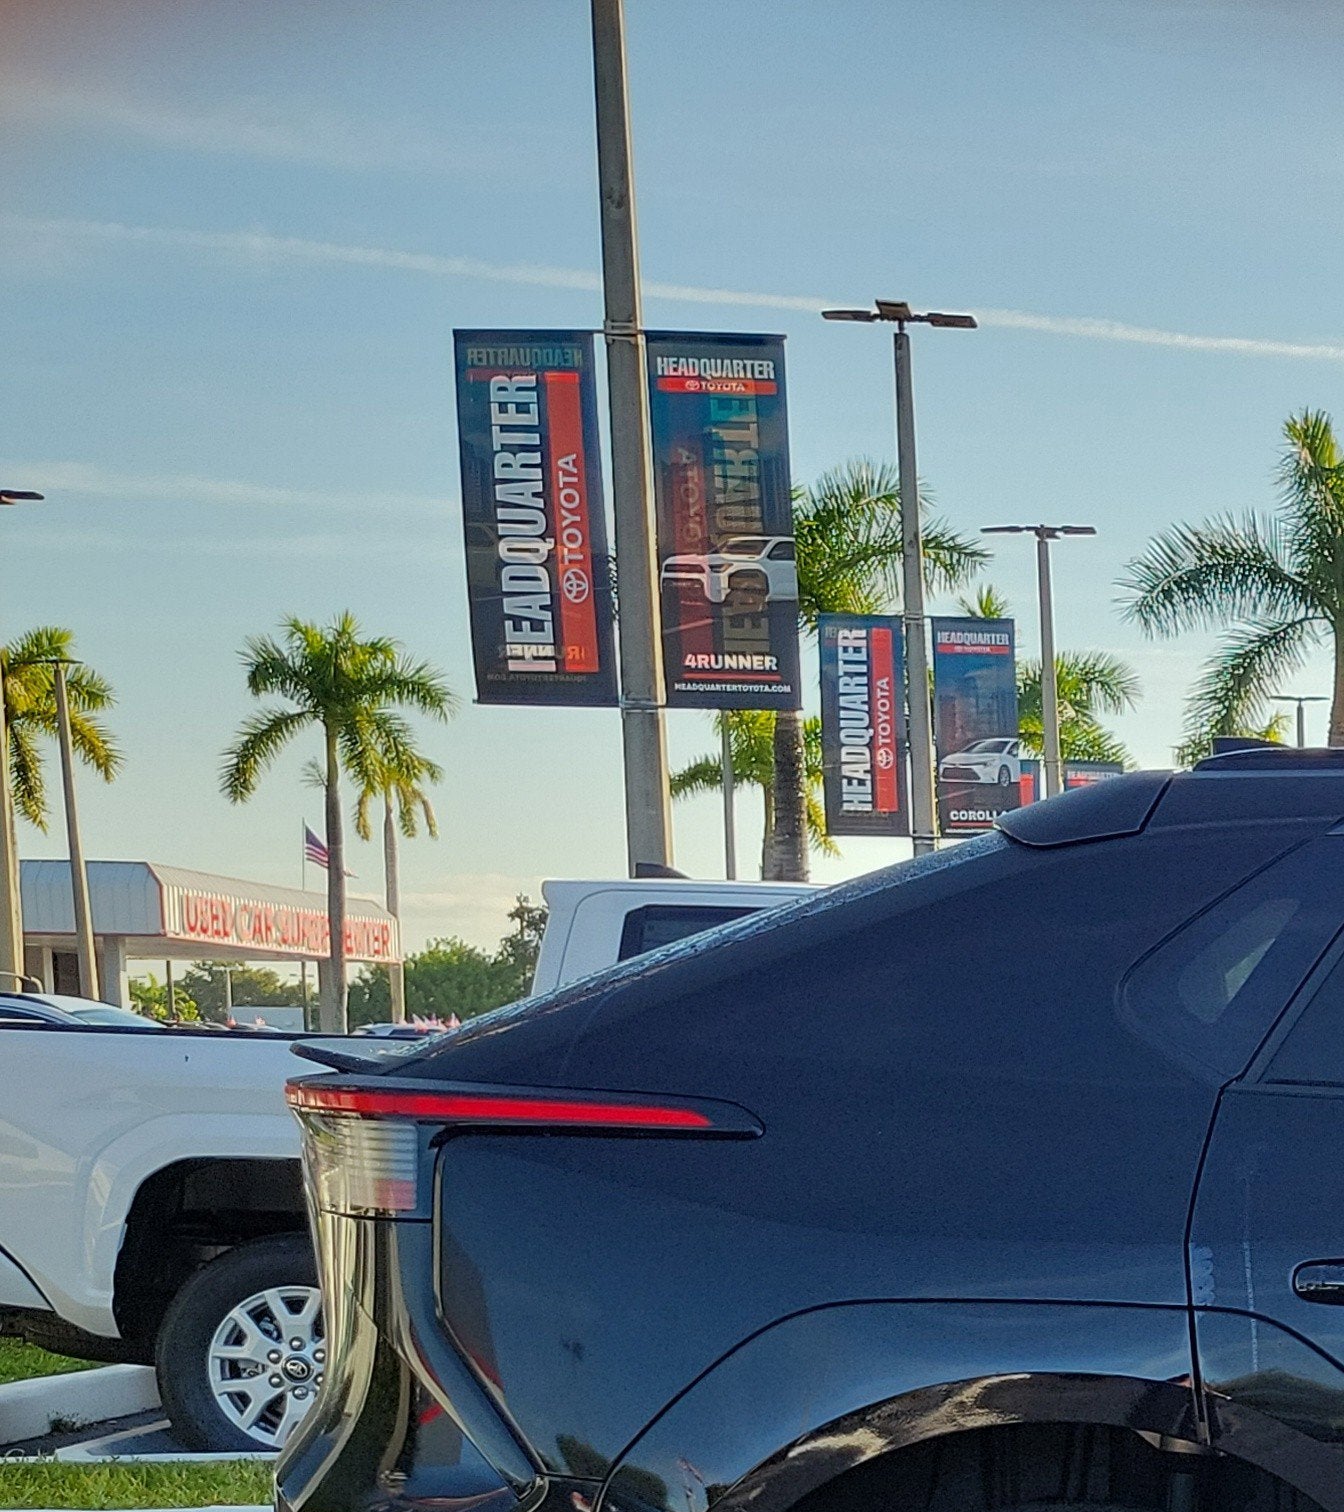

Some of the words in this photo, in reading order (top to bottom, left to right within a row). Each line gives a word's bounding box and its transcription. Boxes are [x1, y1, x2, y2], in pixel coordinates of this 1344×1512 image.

[656, 356, 775, 379] HEADQUARTER
[699, 382, 746, 392] TOYOTA
[557, 453, 584, 565] TOYOTA
[490, 374, 557, 672] HEADQUARTER
[937, 631, 1010, 645] HEADQUARTER
[684, 653, 778, 671] 4RUNNER
[674, 682, 791, 694] HEADQUARTERTOYOTA.COM
[838, 628, 874, 812] HEADQUARTER
[876, 677, 892, 746] TOYOTA
[950, 809, 1007, 821] COROLL
[185, 895, 234, 938] USED
[236, 903, 275, 943] CAR
[342, 919, 390, 955] ENTER
